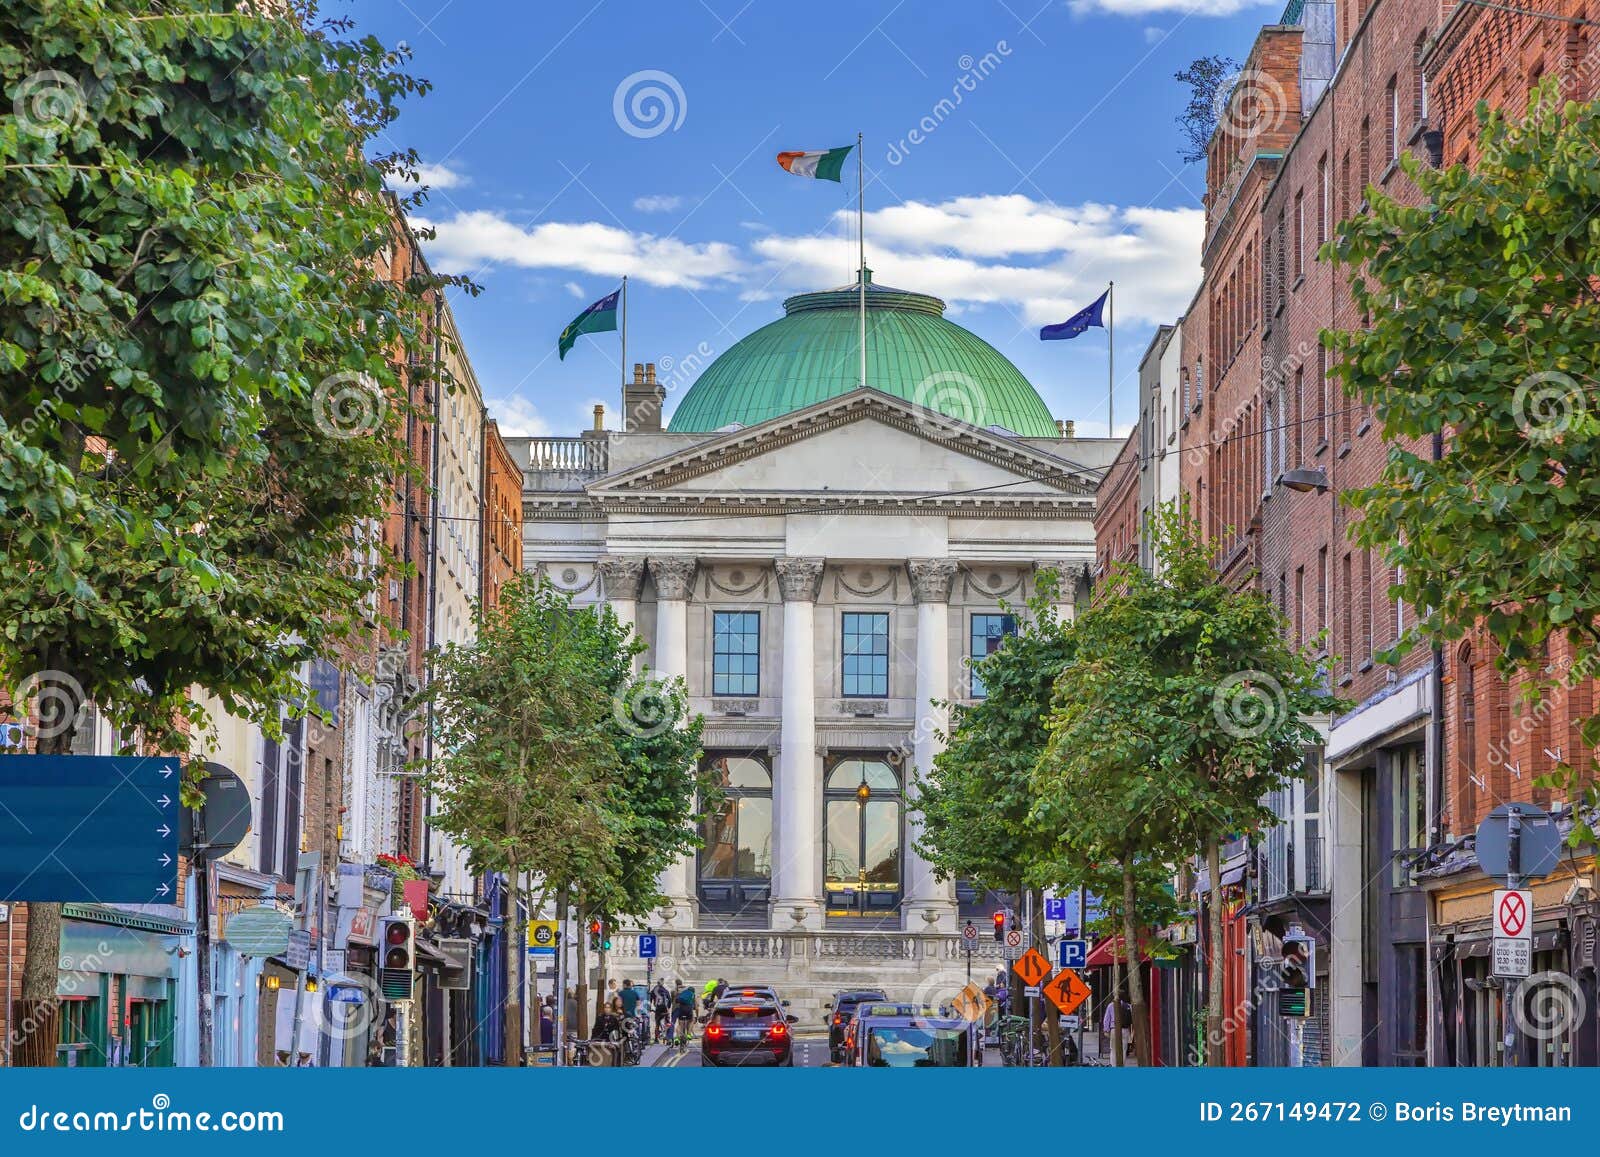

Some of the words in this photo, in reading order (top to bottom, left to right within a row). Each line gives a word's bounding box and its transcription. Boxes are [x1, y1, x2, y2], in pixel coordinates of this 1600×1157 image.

[1051, 900, 1062, 913] P
[643, 937, 652, 949] P
[1065, 944, 1080, 965] P
